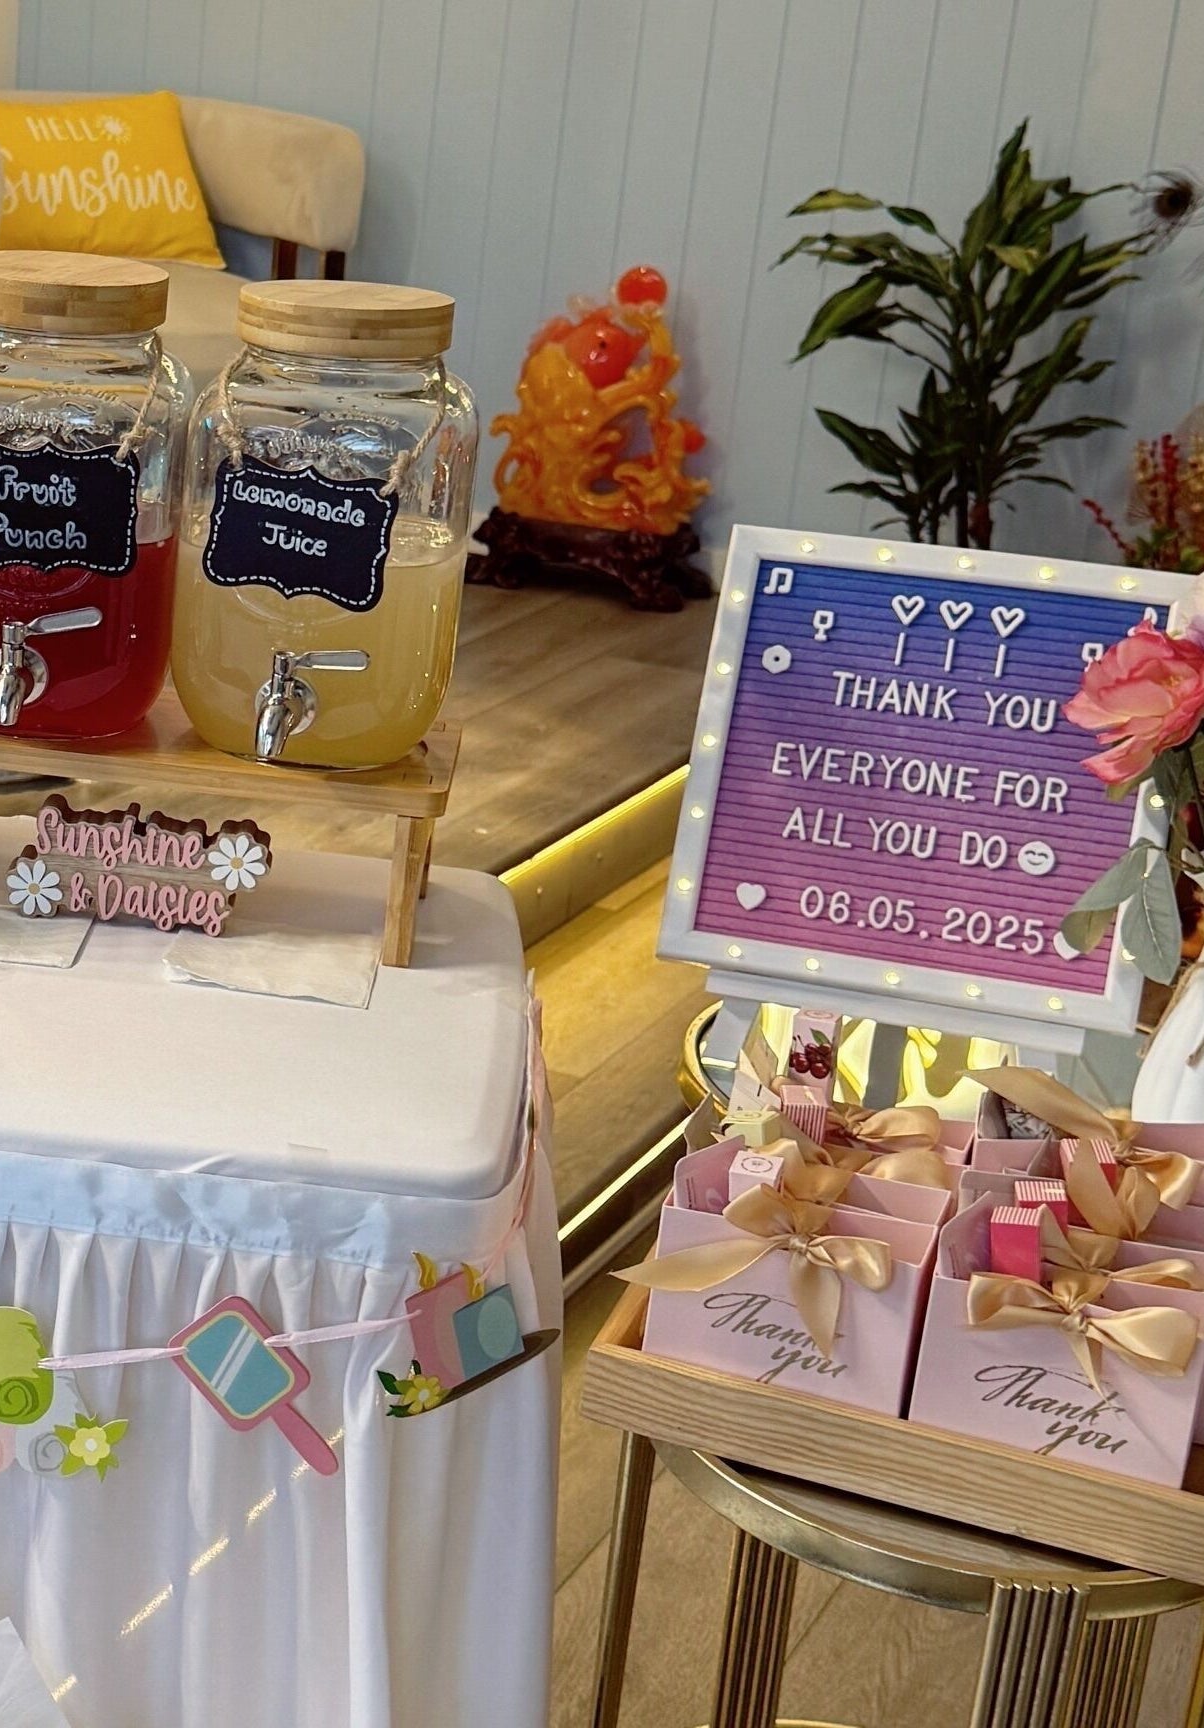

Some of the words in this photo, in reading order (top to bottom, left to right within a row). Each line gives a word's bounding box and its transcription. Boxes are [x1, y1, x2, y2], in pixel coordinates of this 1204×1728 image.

[232, 479, 366, 528] Lemonade
[262, 521, 328, 558] Juice
[832, 670, 958, 721] THANK
[985, 691, 1057, 733] YOU
[771, 742, 980, 802] EVERYONE
[994, 770, 1069, 814] FOR
[36, 806, 206, 870] Sunshine
[782, 806, 852, 849] ALL
[869, 817, 937, 860] YOU
[959, 831, 1008, 869] DO
[98, 873, 230, 937] Daisies
[800, 884, 1045, 956] 06.05.2025
[756, 1346, 848, 1384] you
[1033, 1420, 1128, 1456] you
